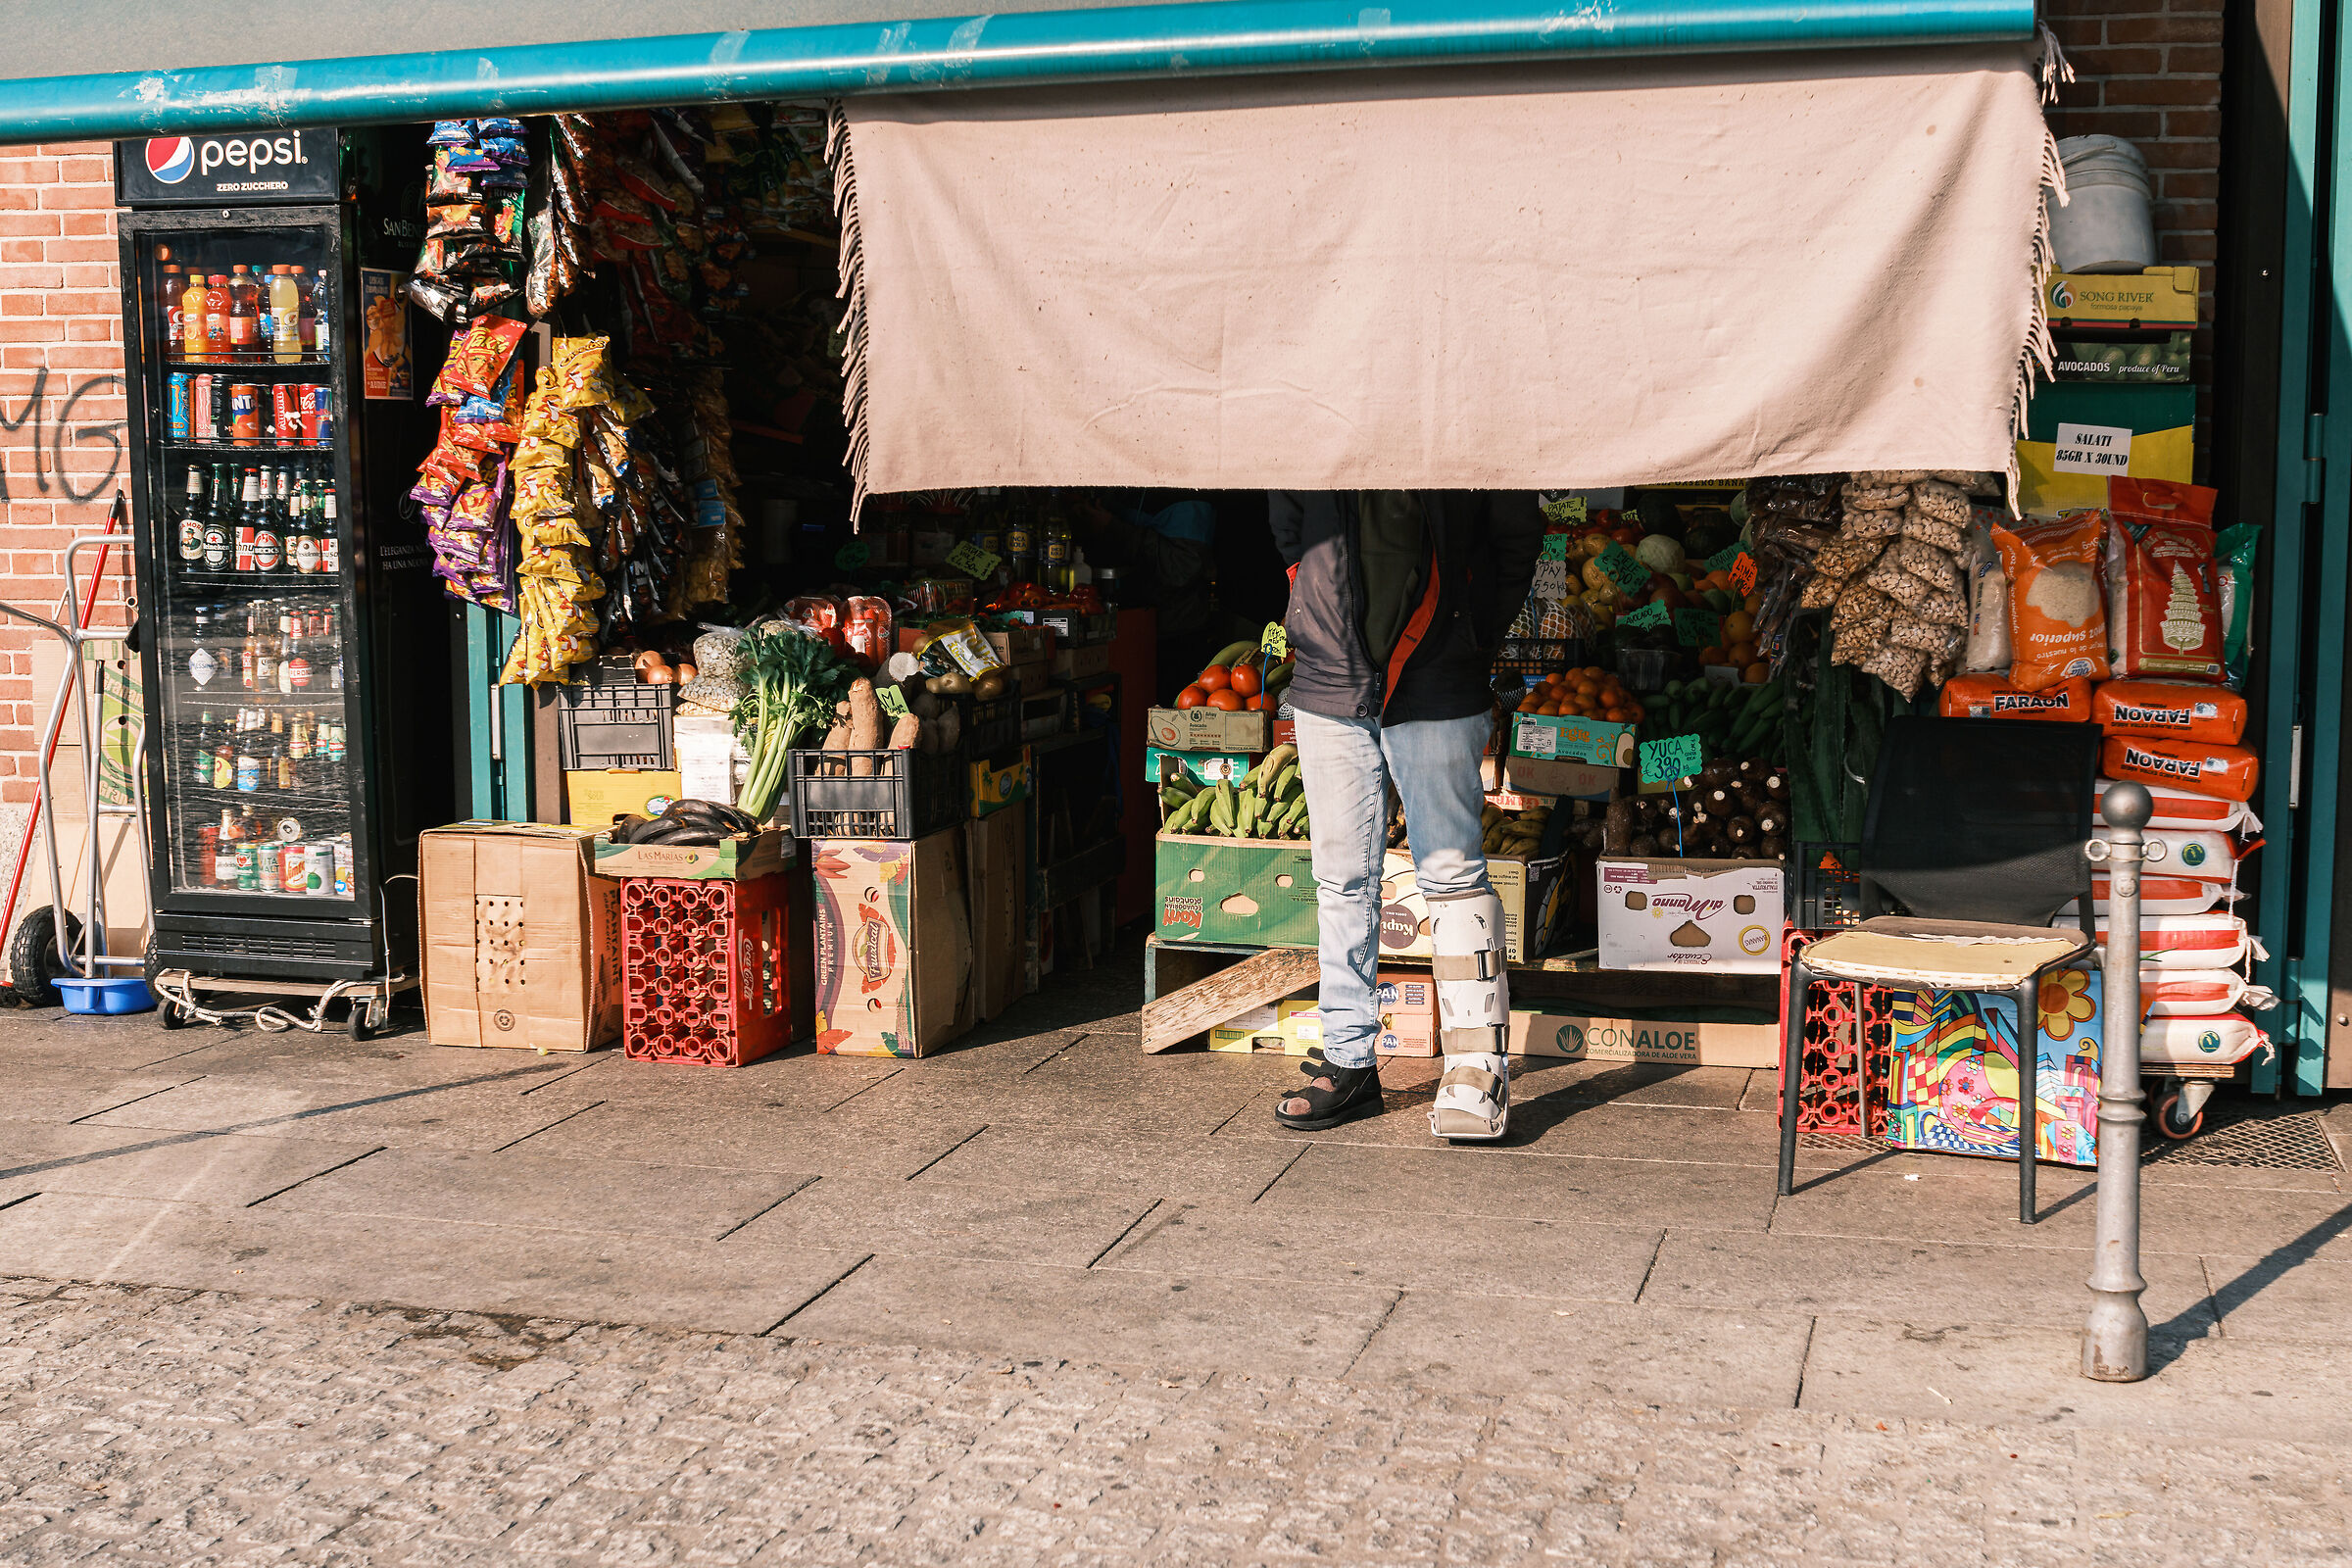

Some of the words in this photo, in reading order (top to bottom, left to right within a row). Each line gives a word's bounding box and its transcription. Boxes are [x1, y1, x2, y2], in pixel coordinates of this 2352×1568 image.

[201, 129, 302, 176] pepsi
[216, 182, 240, 192] ZERO
[240, 181, 289, 191] ZUCCHERO
[2080, 291, 2115, 303] SONG
[2118, 292, 2154, 303] RIVER
[2119, 304, 2143, 313] papaya
[2058, 361, 2110, 371] AVOCADOS
[2118, 365, 2149, 374] produce
[2151, 364, 2160, 374] of
[2075, 433, 2113, 447] SALATI
[2056, 450, 2083, 463] 85GR
[2084, 452, 2094, 464] X
[2095, 452, 2129, 466] 30UND
[2030, 630, 2086, 647] superior
[2036, 648, 2067, 660] nuestro
[1994, 692, 2070, 712] FARAON
[2114, 703, 2191, 725] FARAON
[1559, 726, 1591, 743] Egle
[1647, 740, 1684, 760] YUCA
[2125, 747, 2203, 777] FARAON
[1517, 765, 1536, 779] OK
[1579, 773, 1597, 785] OK
[638, 851, 654, 860] LAS
[1164, 896, 1202, 905] plantains
[1164, 903, 1202, 911] ECUADORIAN
[818, 908, 827, 956] PLANTAINS
[1381, 918, 1414, 937] Kapi
[609, 889, 619, 987] PLANTAINS
[1743, 934, 1768, 947] BANANAS
[867, 922, 880, 977] Fruxical
[1667, 953, 1713, 964] Ecuador
[819, 956, 828, 986] GREEN
[1587, 1027, 1695, 1051] CONALOE
[1585, 1048, 1650, 1058] COMERCIALIZADORA
